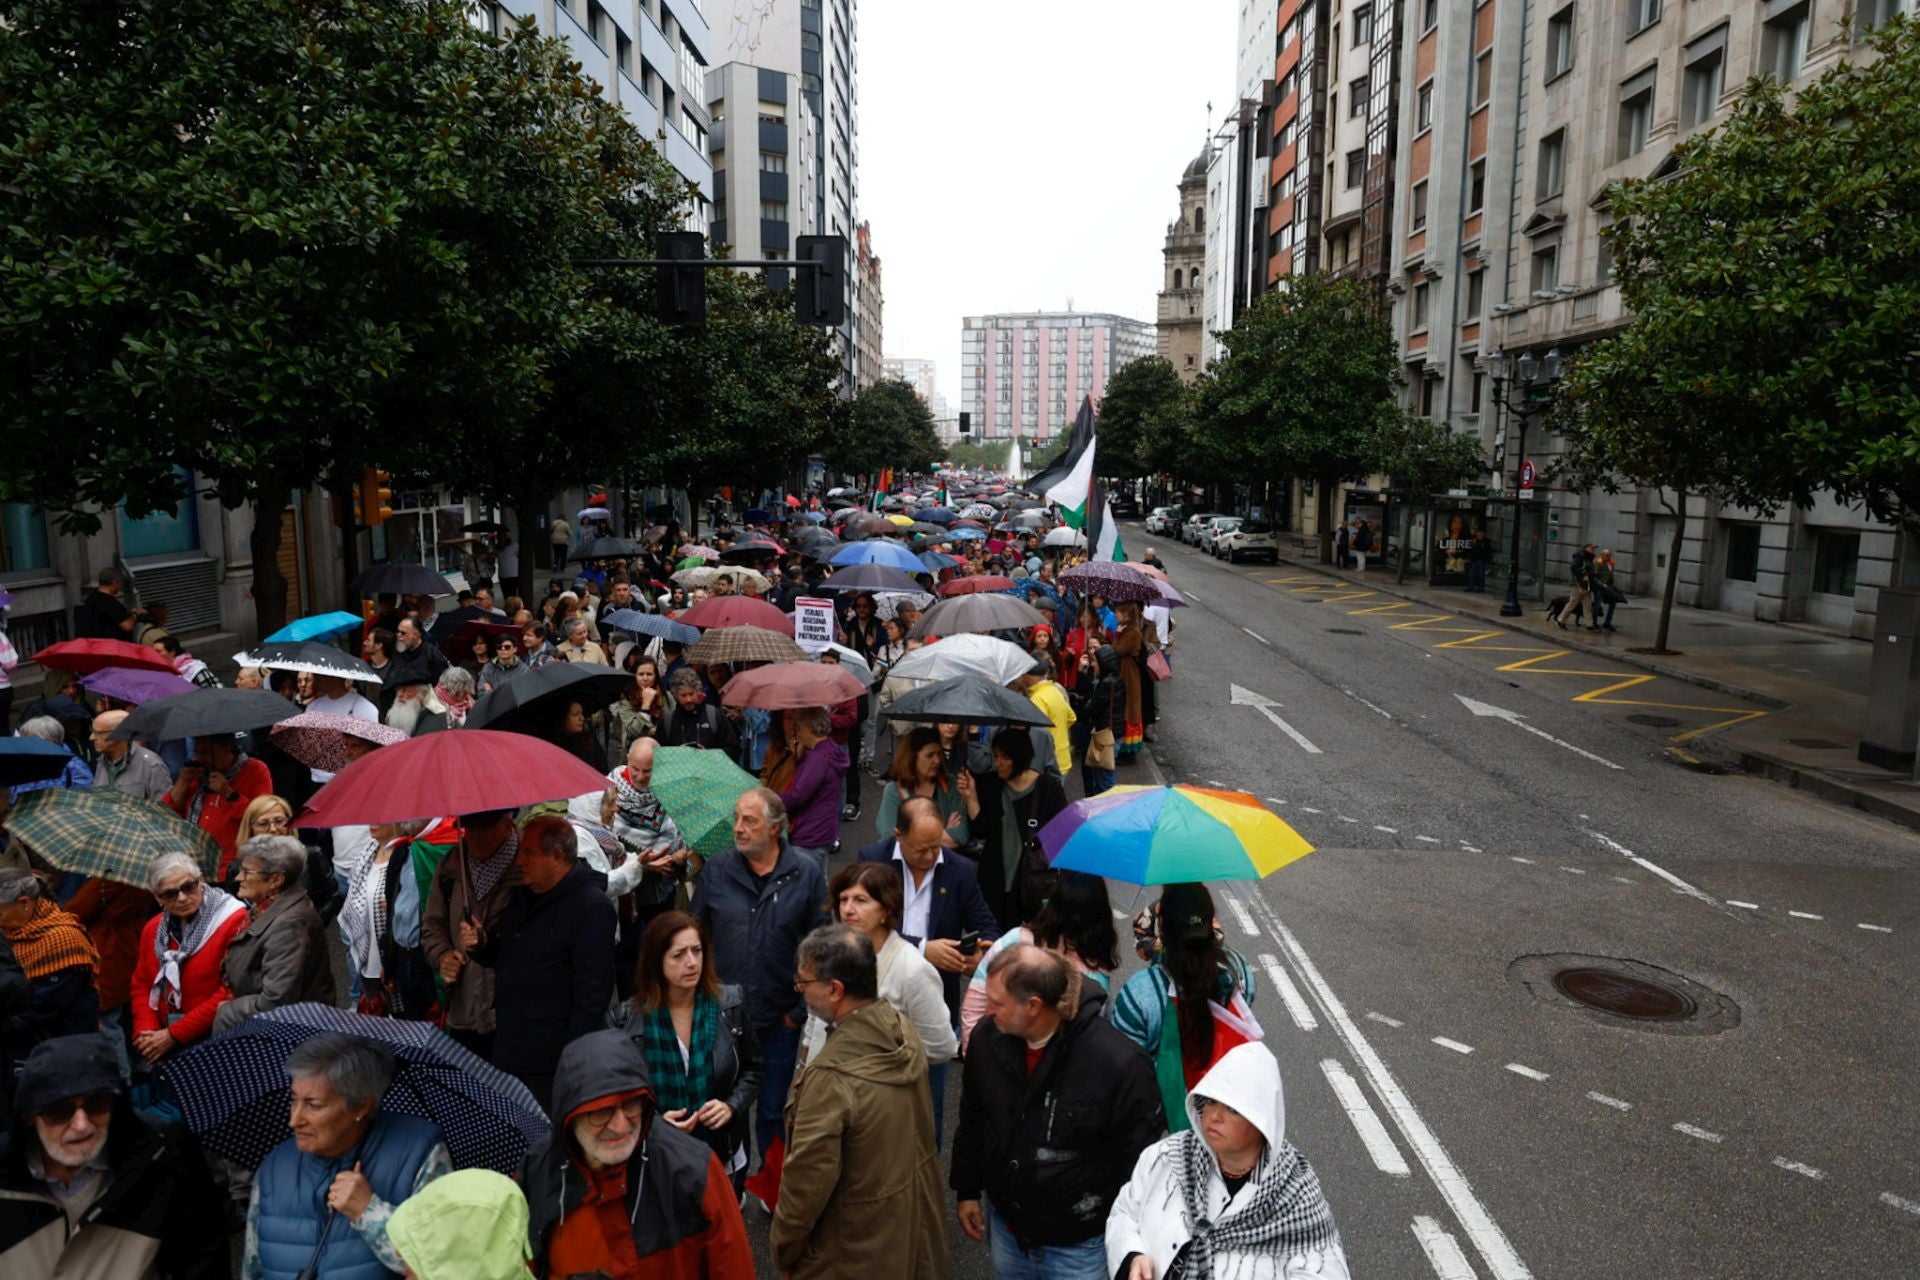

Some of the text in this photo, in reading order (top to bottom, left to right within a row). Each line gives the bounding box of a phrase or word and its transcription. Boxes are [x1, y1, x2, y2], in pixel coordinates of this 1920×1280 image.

[1440, 539, 1472, 549] LIBRE
[804, 608, 824, 616] ISRAEL
[802, 616, 826, 624] ASESINA
[803, 624, 826, 632] EUROPA
[798, 632, 830, 641] PATROCINA
